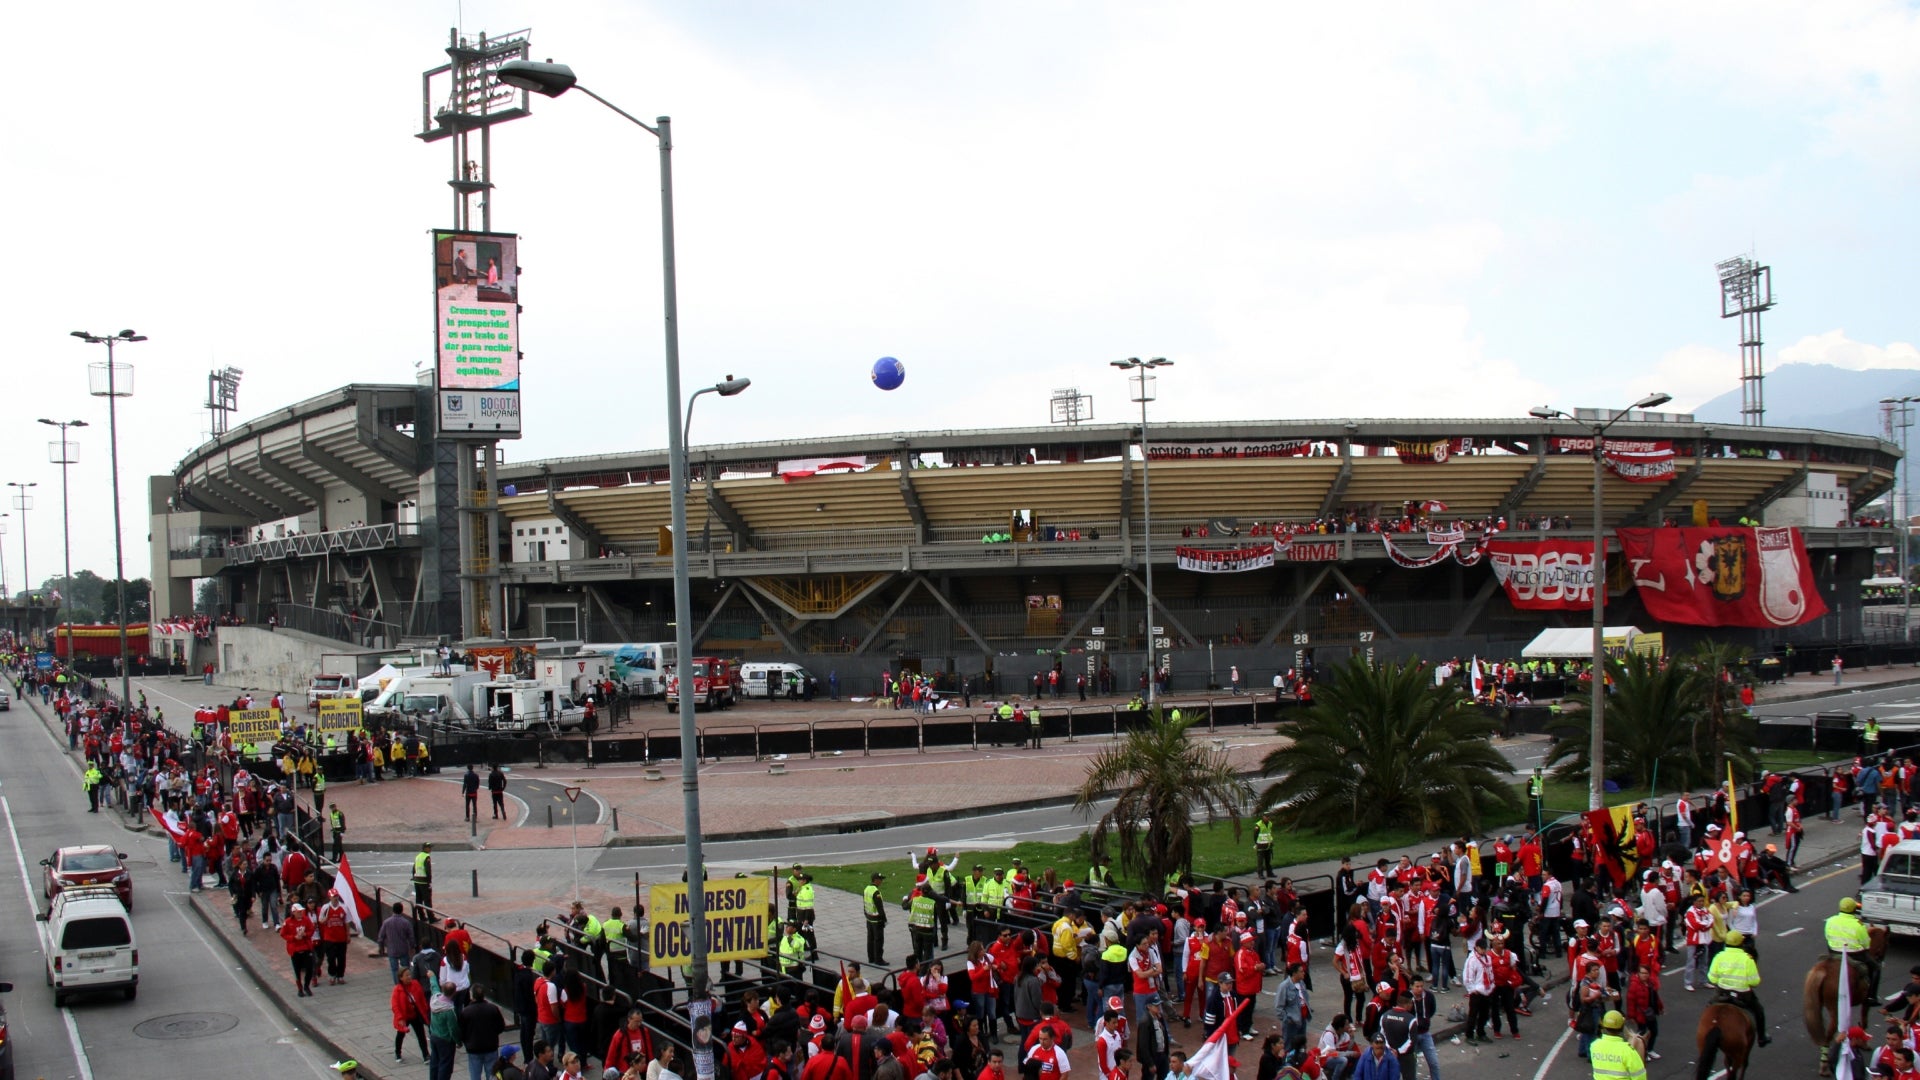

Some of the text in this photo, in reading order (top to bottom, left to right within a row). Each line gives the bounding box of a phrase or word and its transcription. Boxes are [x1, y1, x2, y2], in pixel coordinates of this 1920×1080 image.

[450, 306, 506, 317] Creemos que
[458, 320, 510, 328] prosperidad
[498, 332, 508, 340] de
[445, 342, 513, 352] dar para recibir
[456, 354, 502, 364] de manera
[480, 395, 518, 410] BOGOTÁ
[1604, 441, 1657, 452] SIEMPRE
[1287, 543, 1338, 561] ROMA
[1293, 634, 1309, 644] 28
[1360, 631, 1374, 641] 27
[1086, 640, 1101, 651] 30
[1155, 638, 1170, 648] 29
[239, 710, 270, 720] INGRESO
[321, 711, 360, 729] OCCIDENTAL
[231, 719, 280, 733] CORTESIA
[1718, 839, 1732, 863] 8
[675, 888, 747, 914] INRESO
[654, 915, 764, 959] OCCDENTAL
[1593, 1052, 1623, 1063] POLICIA
